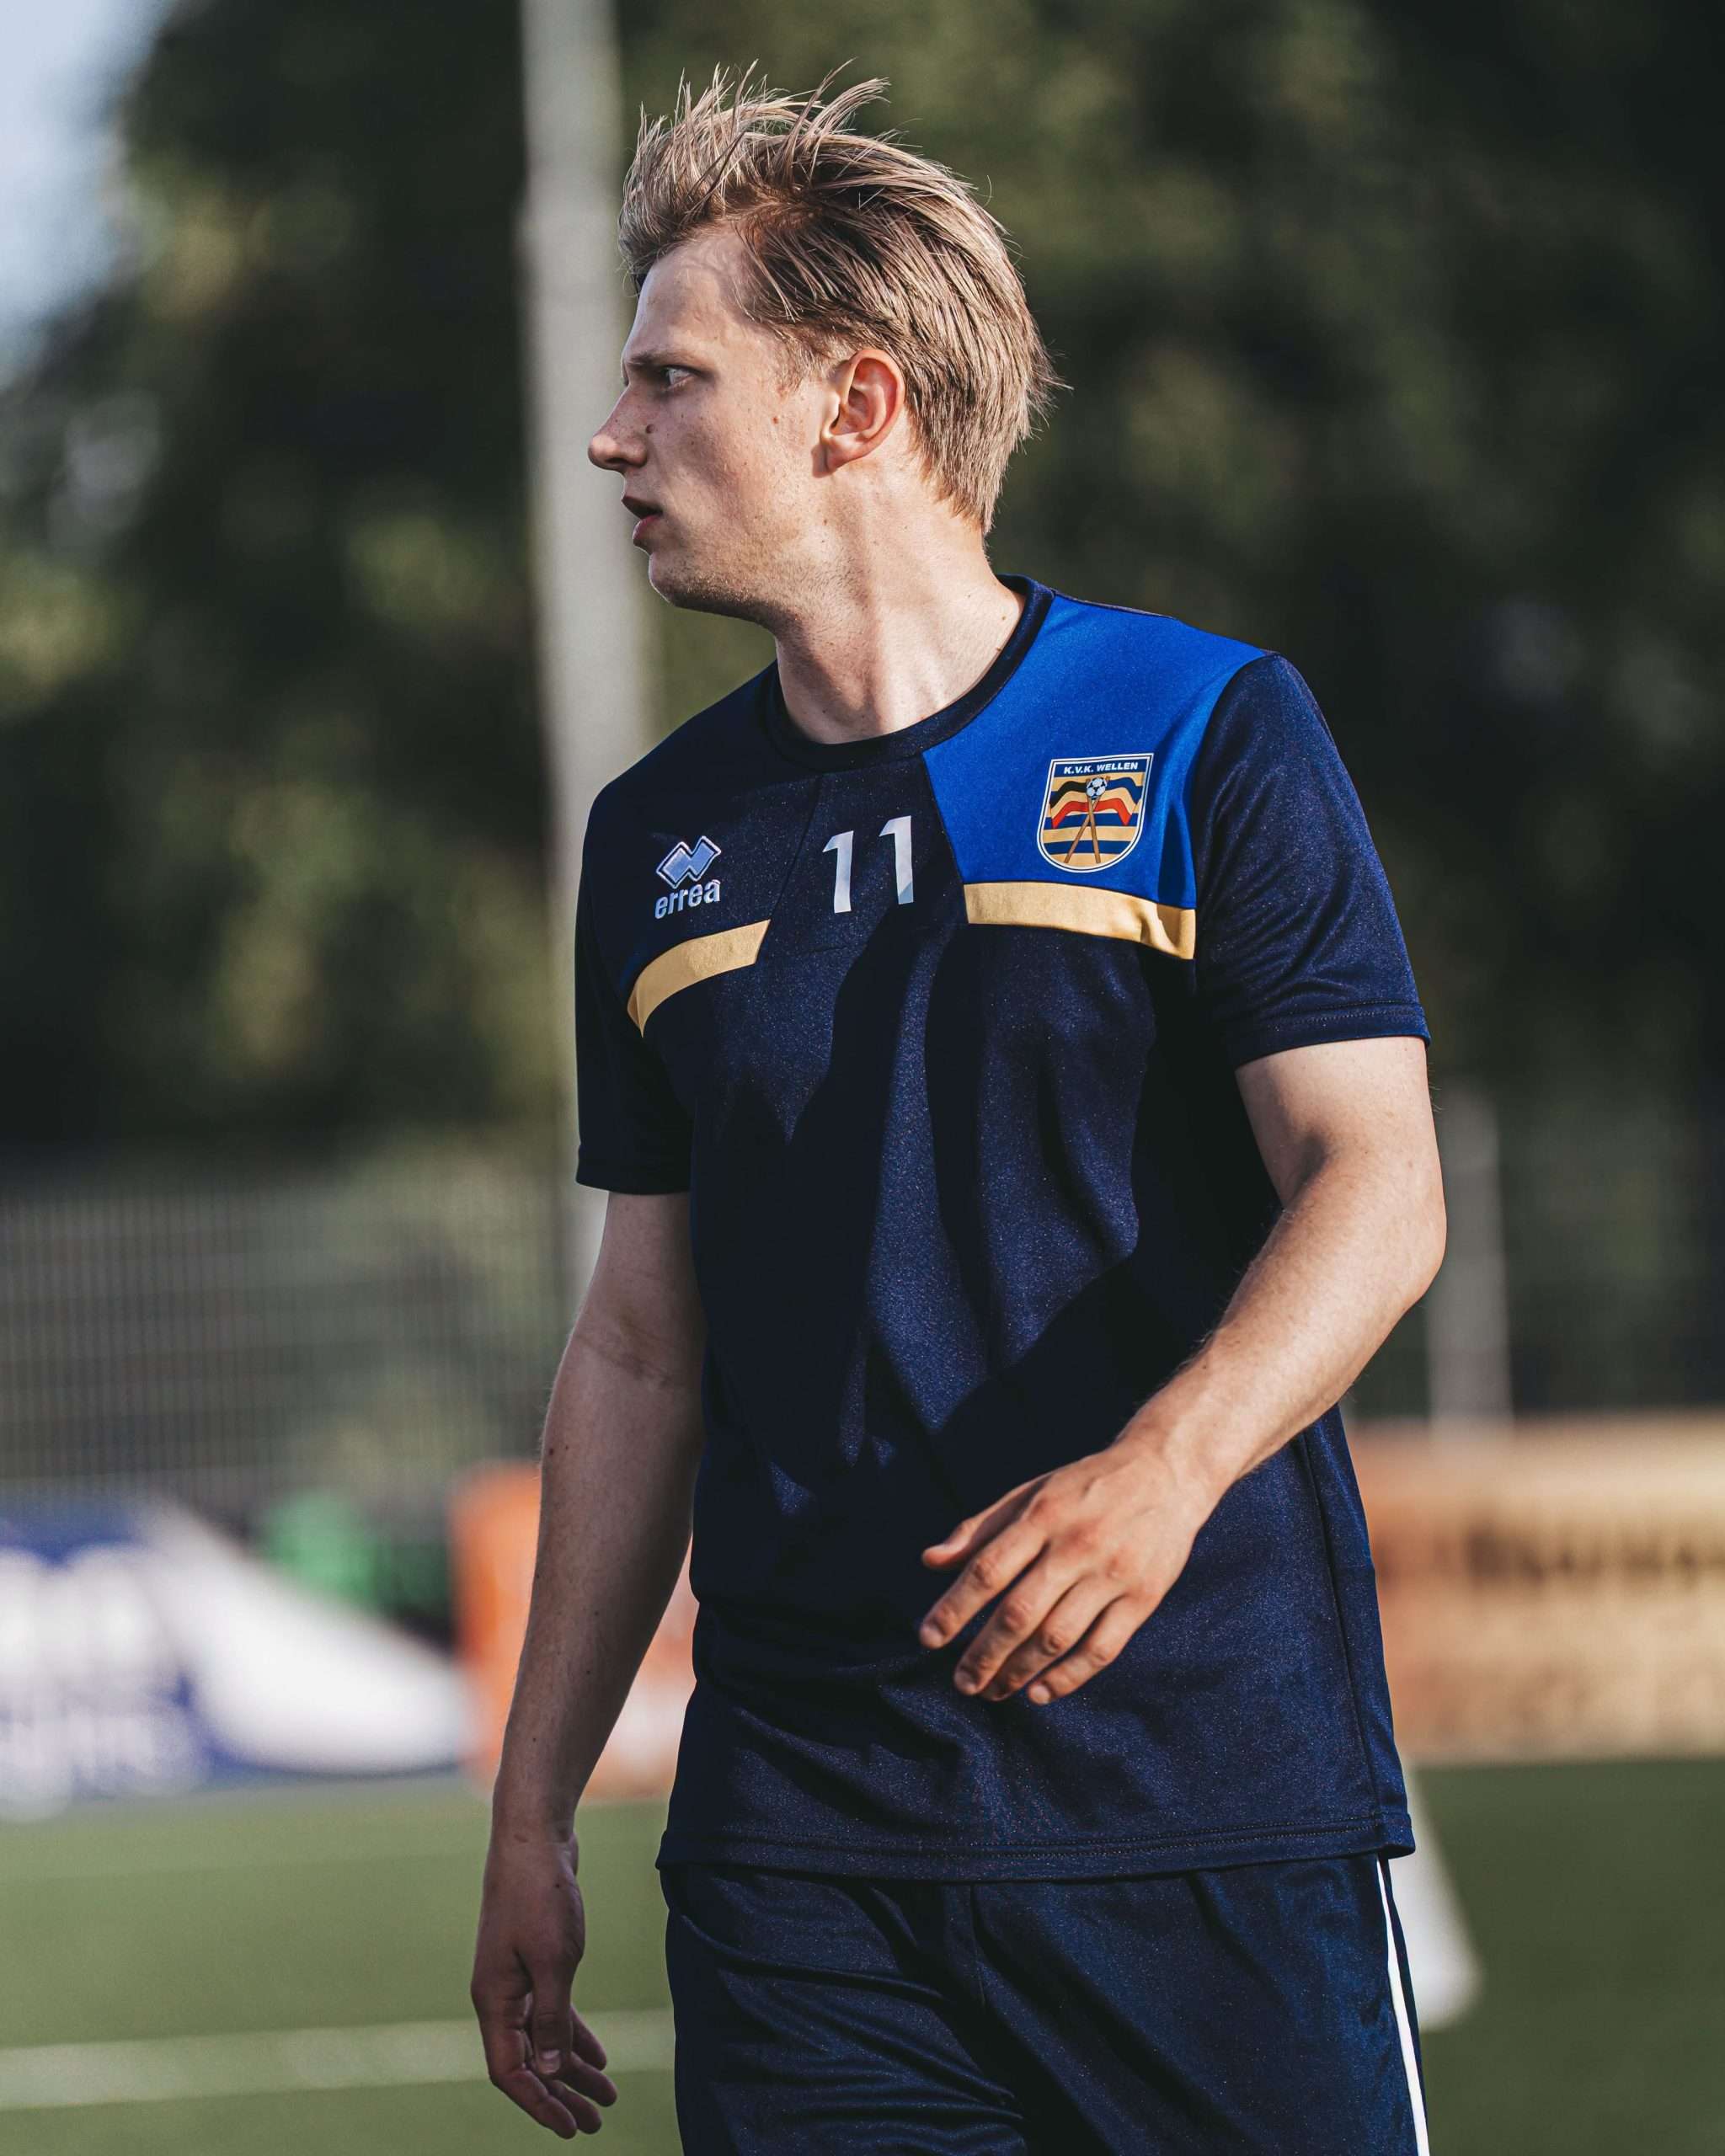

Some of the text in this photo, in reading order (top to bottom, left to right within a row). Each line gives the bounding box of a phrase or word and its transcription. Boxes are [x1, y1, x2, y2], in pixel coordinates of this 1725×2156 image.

[1063, 762, 1139, 775] K.V.K. WELLEN
[822, 815, 914, 914] 11
